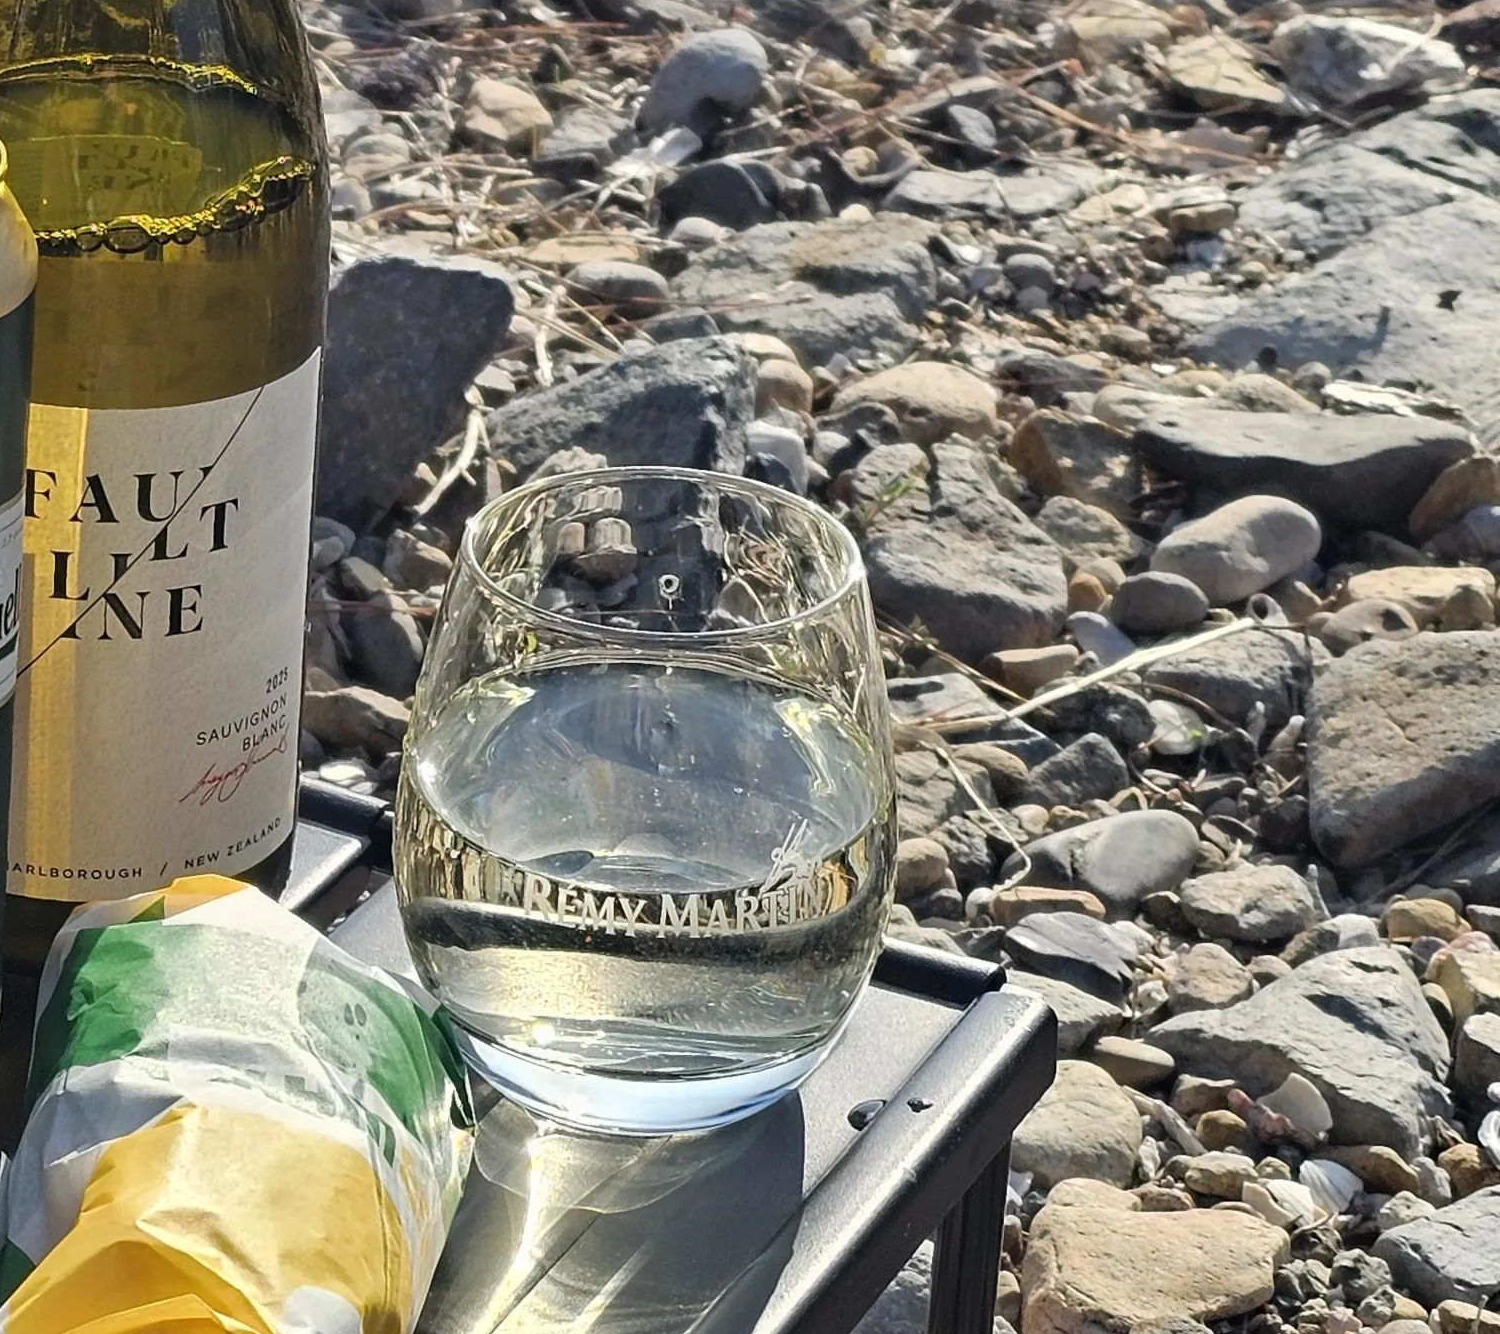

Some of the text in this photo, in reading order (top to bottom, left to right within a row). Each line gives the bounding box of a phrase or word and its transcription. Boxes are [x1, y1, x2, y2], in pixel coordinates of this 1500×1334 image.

[24, 465, 239, 562] FAULT
[48, 550, 205, 641] LINE
[195, 692, 288, 746] SAUVIGNON
[242, 714, 287, 752] BLANC
[7, 862, 143, 881] ARLBOROUGH
[184, 849, 221, 871] NEW
[227, 816, 282, 857] ZEALAND
